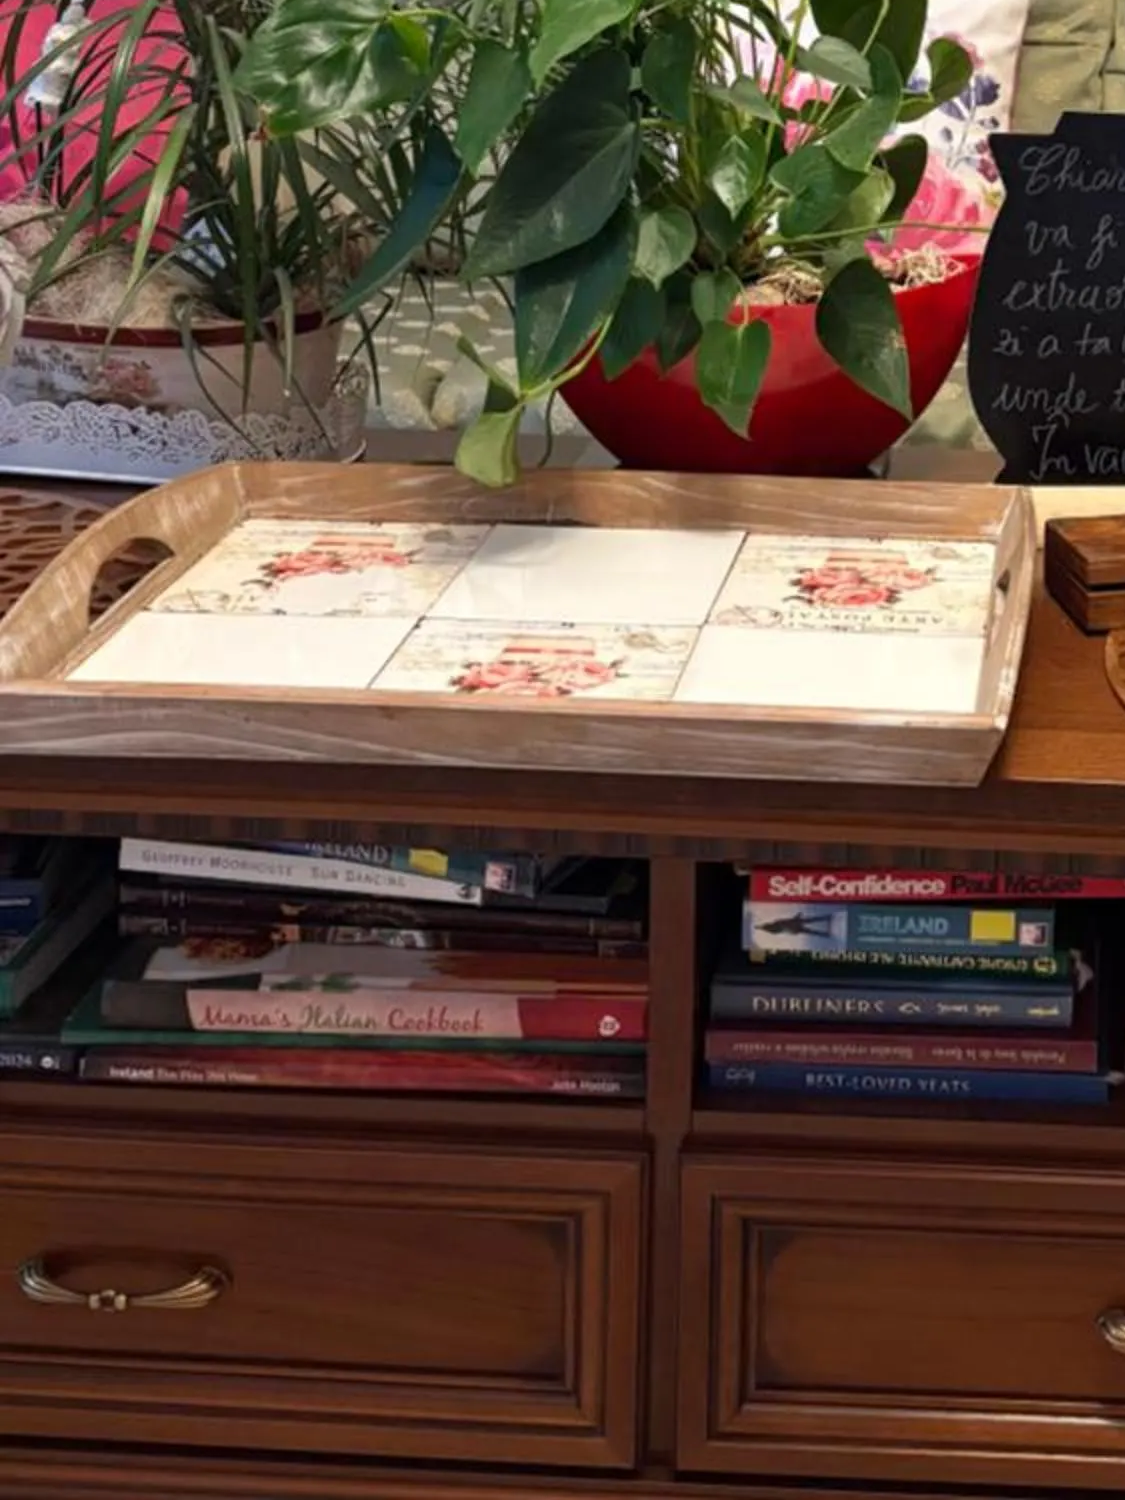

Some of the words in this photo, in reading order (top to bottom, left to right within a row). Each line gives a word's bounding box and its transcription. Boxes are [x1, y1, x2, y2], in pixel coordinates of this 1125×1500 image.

[768, 874, 947, 897] Self-Confidence
[857, 915, 950, 937] IRELAND
[752, 996, 883, 1014] DUBLINERS
[387, 1006, 486, 1033] Cookbook
[805, 1072, 912, 1092] BEST-LOVED
[917, 1077, 972, 1094] YEATS
